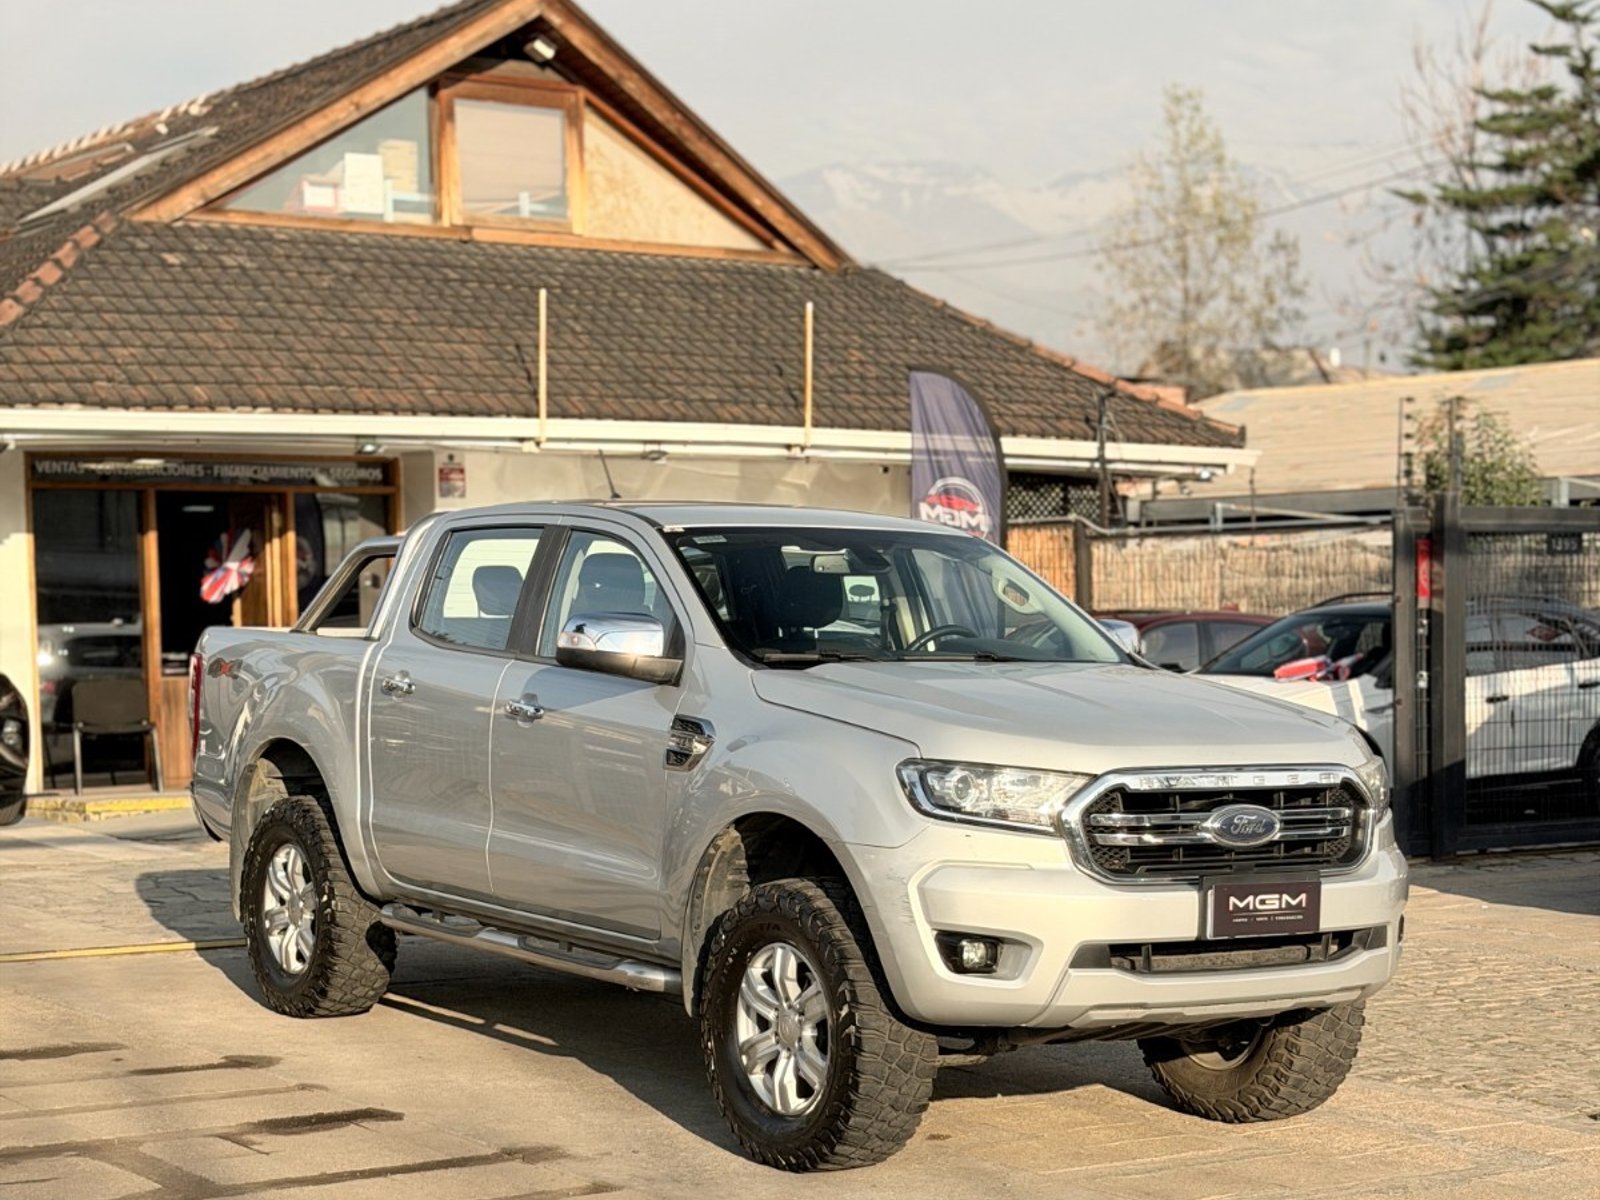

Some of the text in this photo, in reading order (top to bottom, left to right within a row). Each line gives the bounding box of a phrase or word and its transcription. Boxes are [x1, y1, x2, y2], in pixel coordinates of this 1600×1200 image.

[35, 460, 84, 474] VENTAS
[330, 467, 383, 481] SEGUROS
[1139, 773, 1339, 788] RANGER
[1231, 814, 1266, 834] Ford
[1229, 893, 1307, 911] MGM
